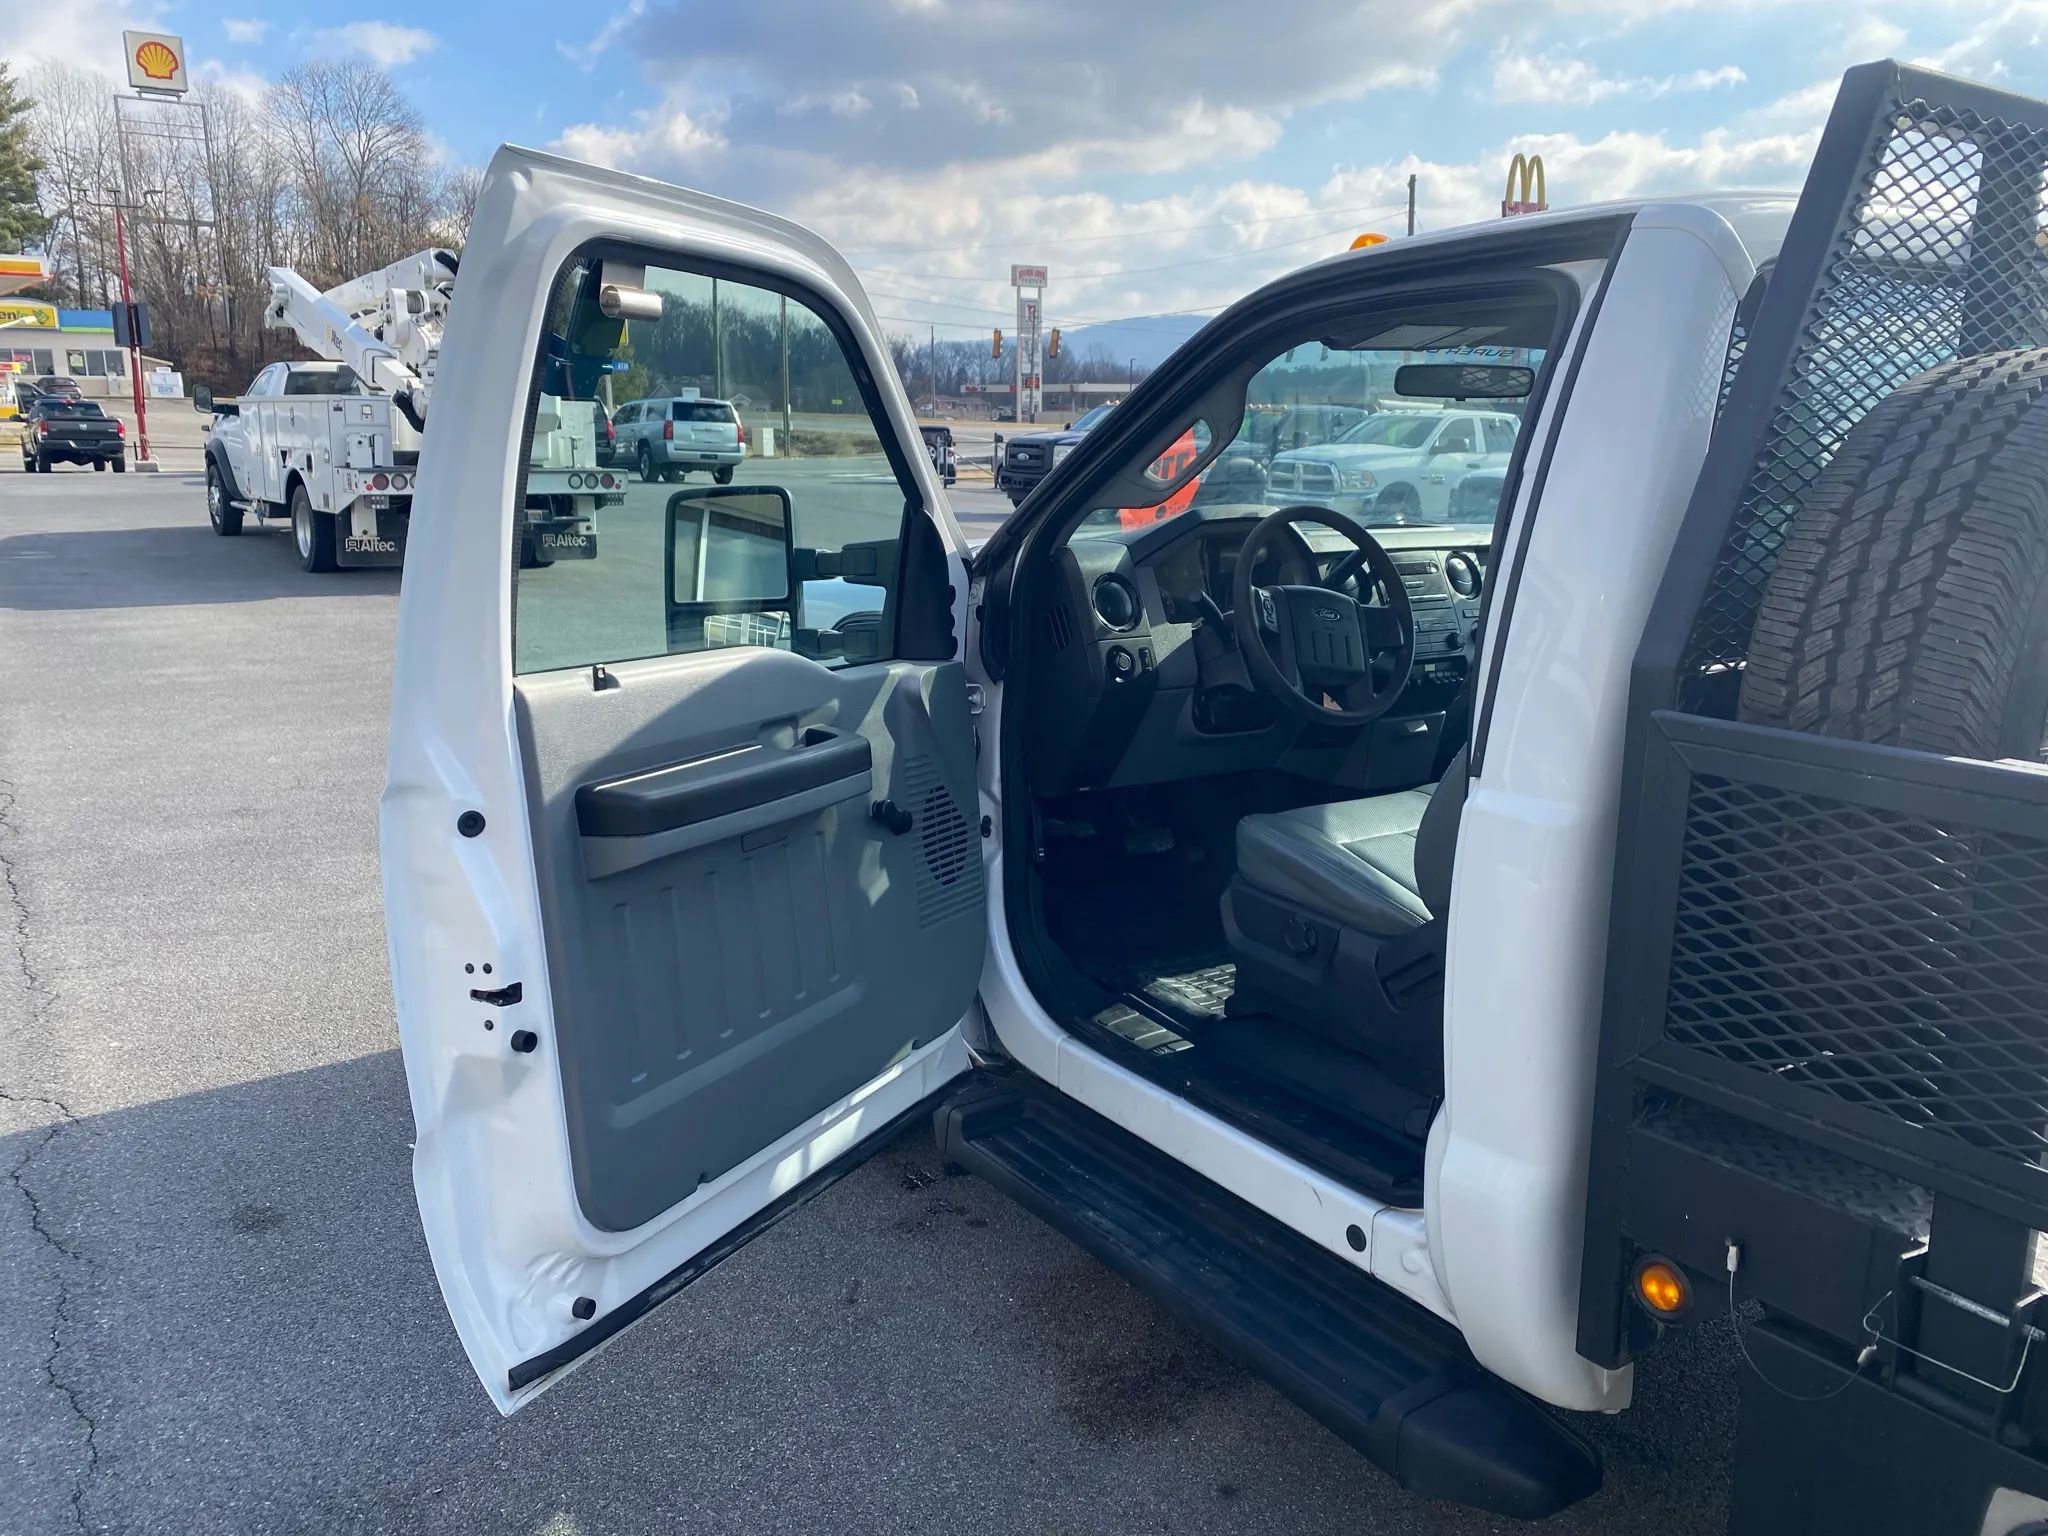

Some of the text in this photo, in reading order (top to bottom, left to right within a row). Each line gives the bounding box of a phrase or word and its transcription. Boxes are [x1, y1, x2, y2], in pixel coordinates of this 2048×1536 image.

[360, 537, 395, 552] Altec
[556, 533, 587, 547] Altec
[1319, 608, 1336, 619] Ford
